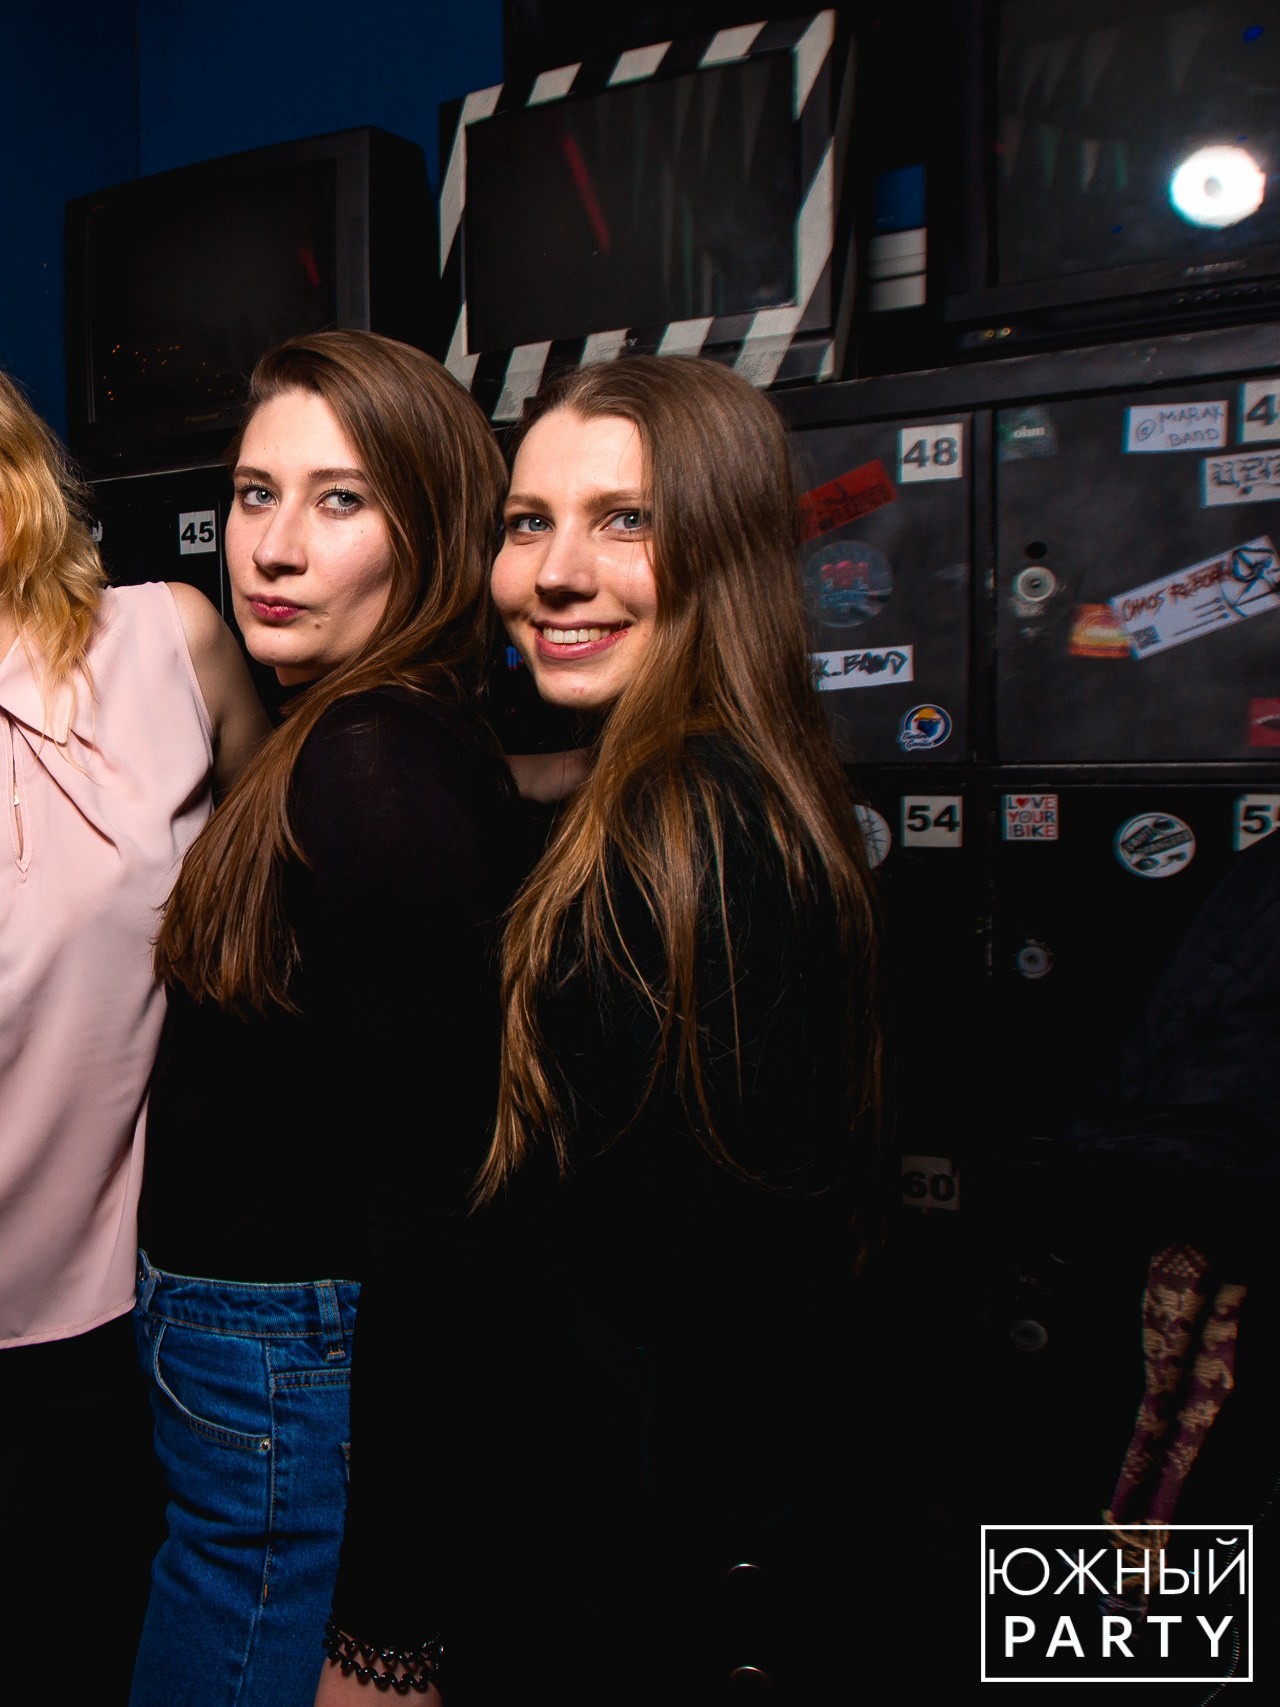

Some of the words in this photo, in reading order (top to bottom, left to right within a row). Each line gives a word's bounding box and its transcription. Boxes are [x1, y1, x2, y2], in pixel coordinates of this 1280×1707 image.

[903, 436, 959, 468] 48
[180, 520, 216, 545] 45
[906, 804, 961, 833] 54
[902, 1170, 956, 1202] 60
